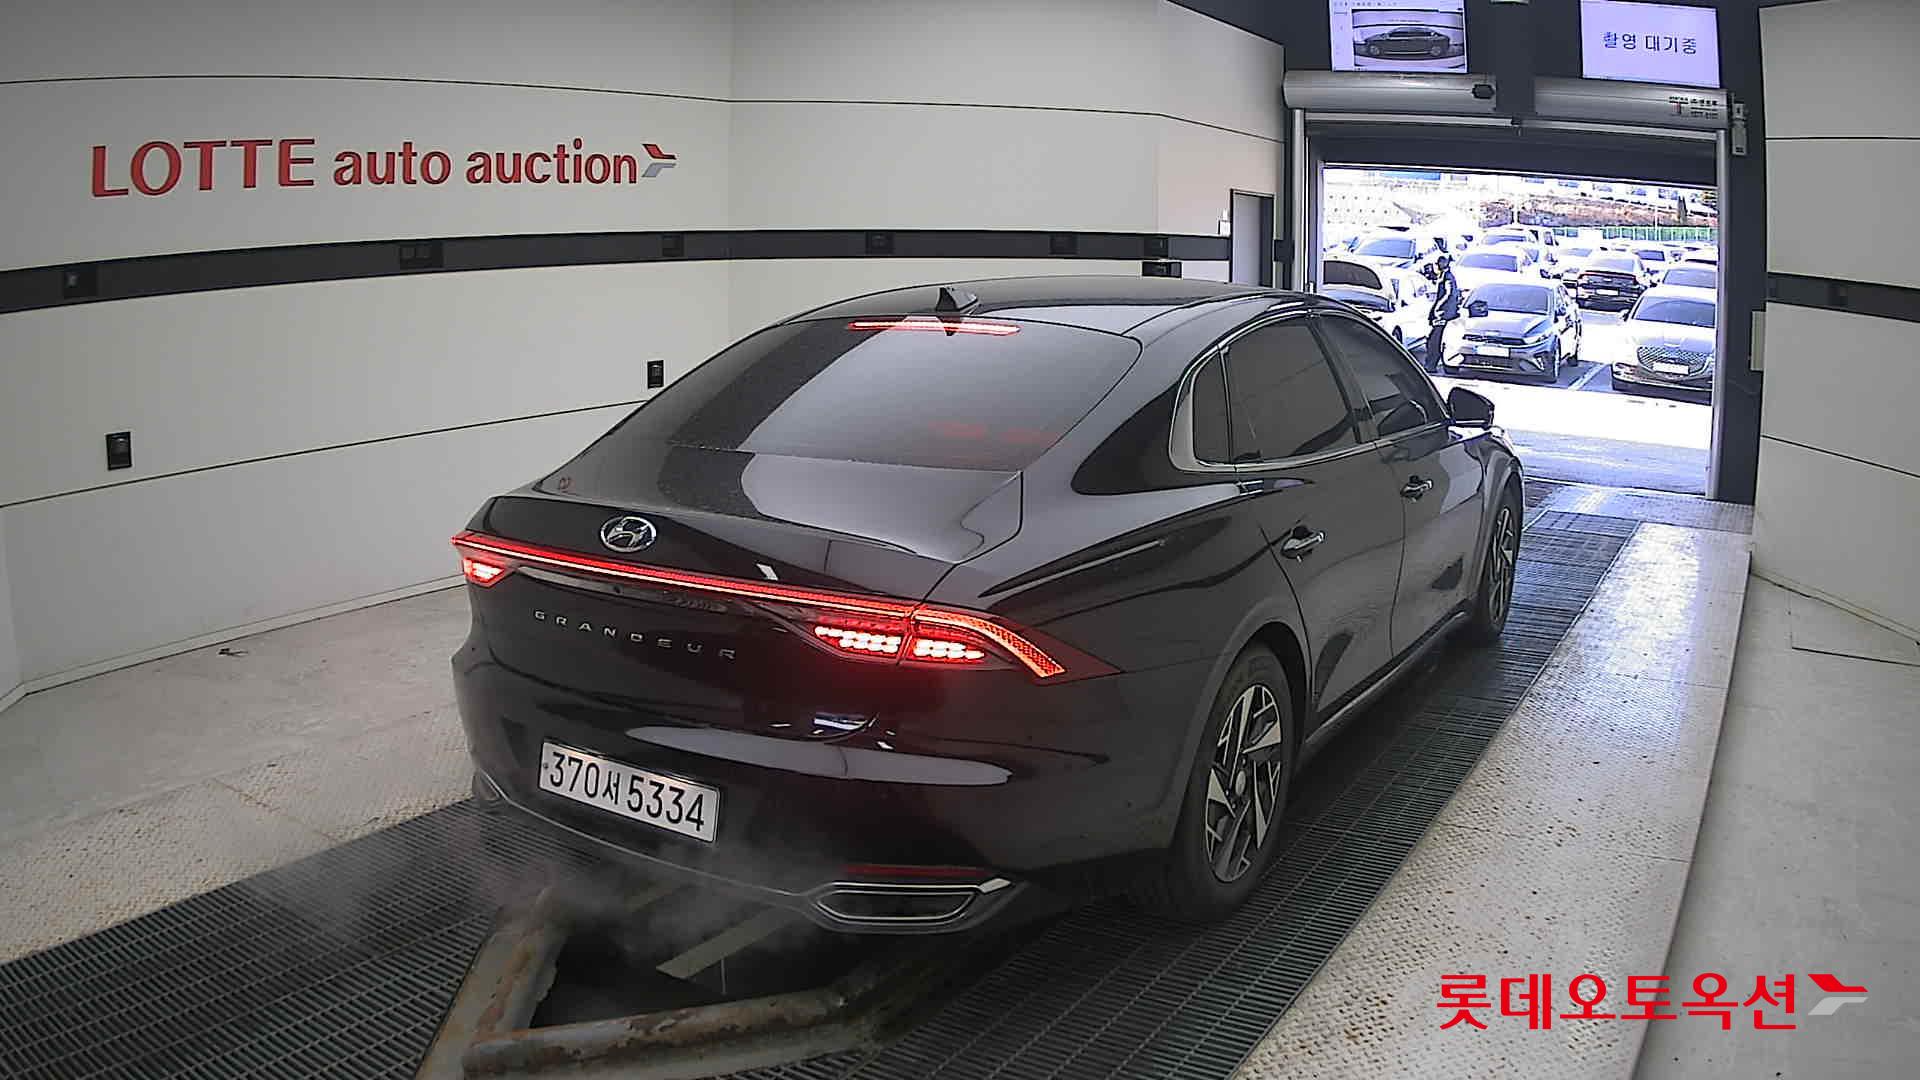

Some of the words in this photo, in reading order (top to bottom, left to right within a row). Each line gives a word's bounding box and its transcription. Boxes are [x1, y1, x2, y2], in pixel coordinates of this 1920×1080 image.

[1645, 35, 1697, 55] 대기중
[92, 138, 316, 198] LOTTE
[334, 142, 452, 187] auto
[466, 138, 638, 185] auction
[534, 610, 736, 660] GRANDEUR
